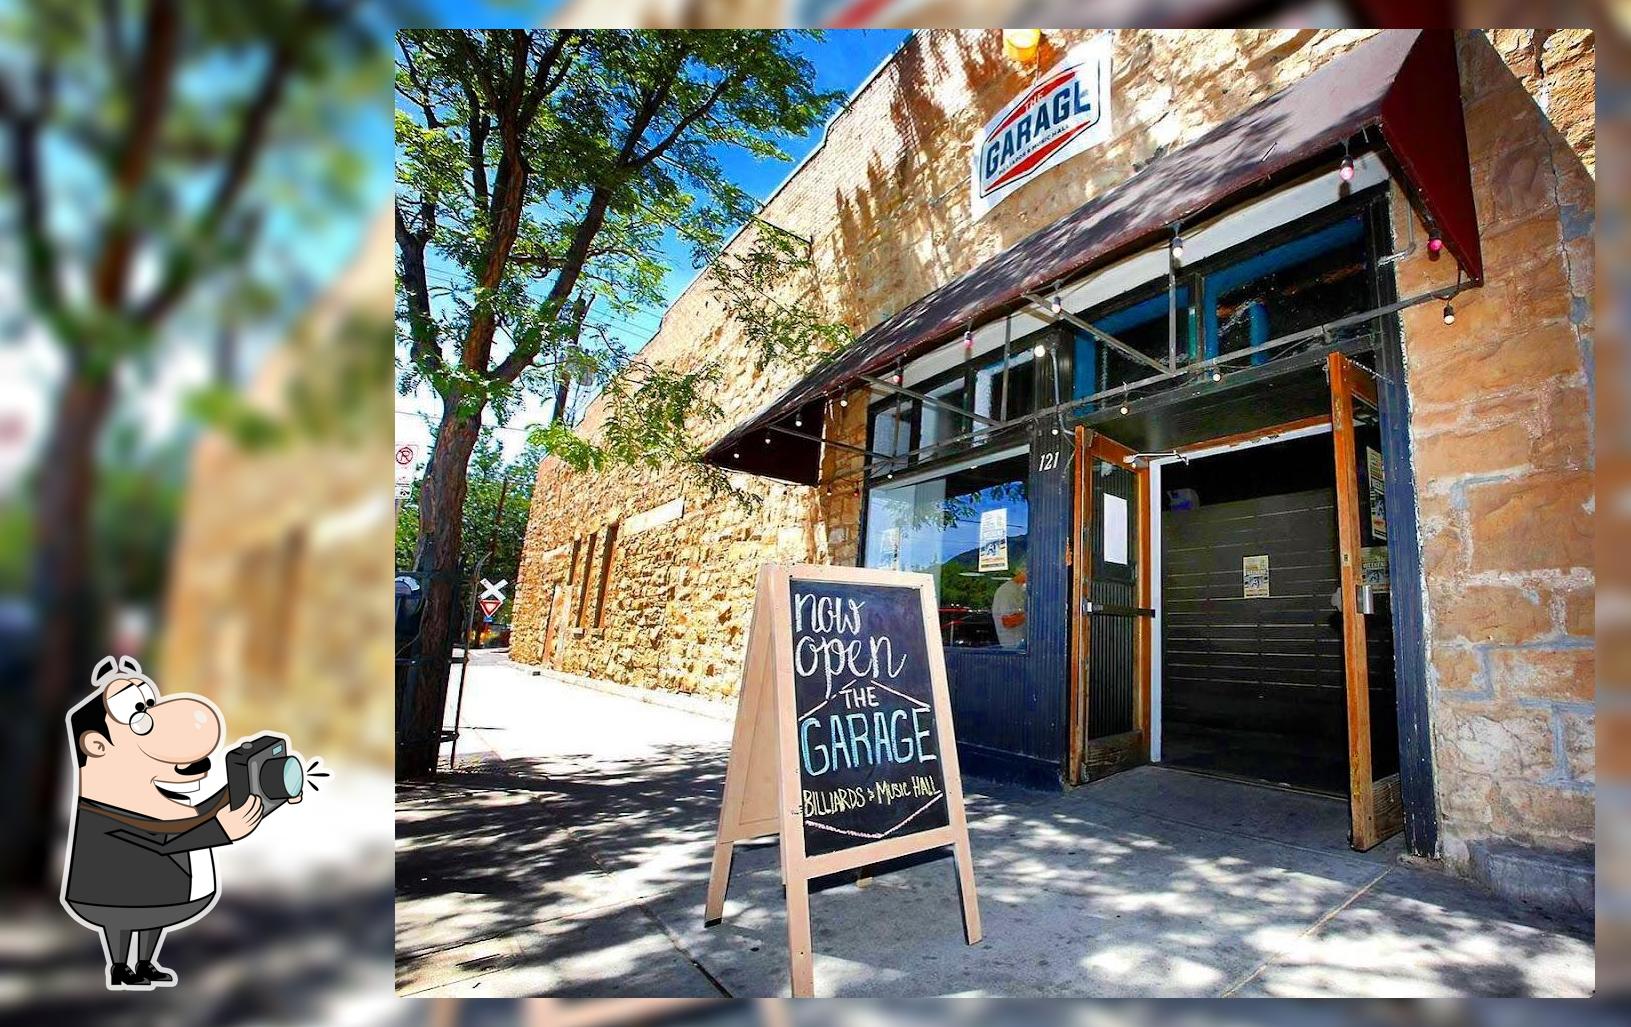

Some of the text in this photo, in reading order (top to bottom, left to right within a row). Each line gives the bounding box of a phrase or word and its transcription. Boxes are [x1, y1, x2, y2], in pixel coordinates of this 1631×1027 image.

[1039, 452, 1059, 471] 121
[795, 593, 865, 634] now
[795, 635, 907, 700] open
[842, 686, 879, 709] THE
[800, 707, 937, 777] GARAGE
[803, 789, 866, 817] BILLIARDS
[911, 775, 942, 797] HALL
